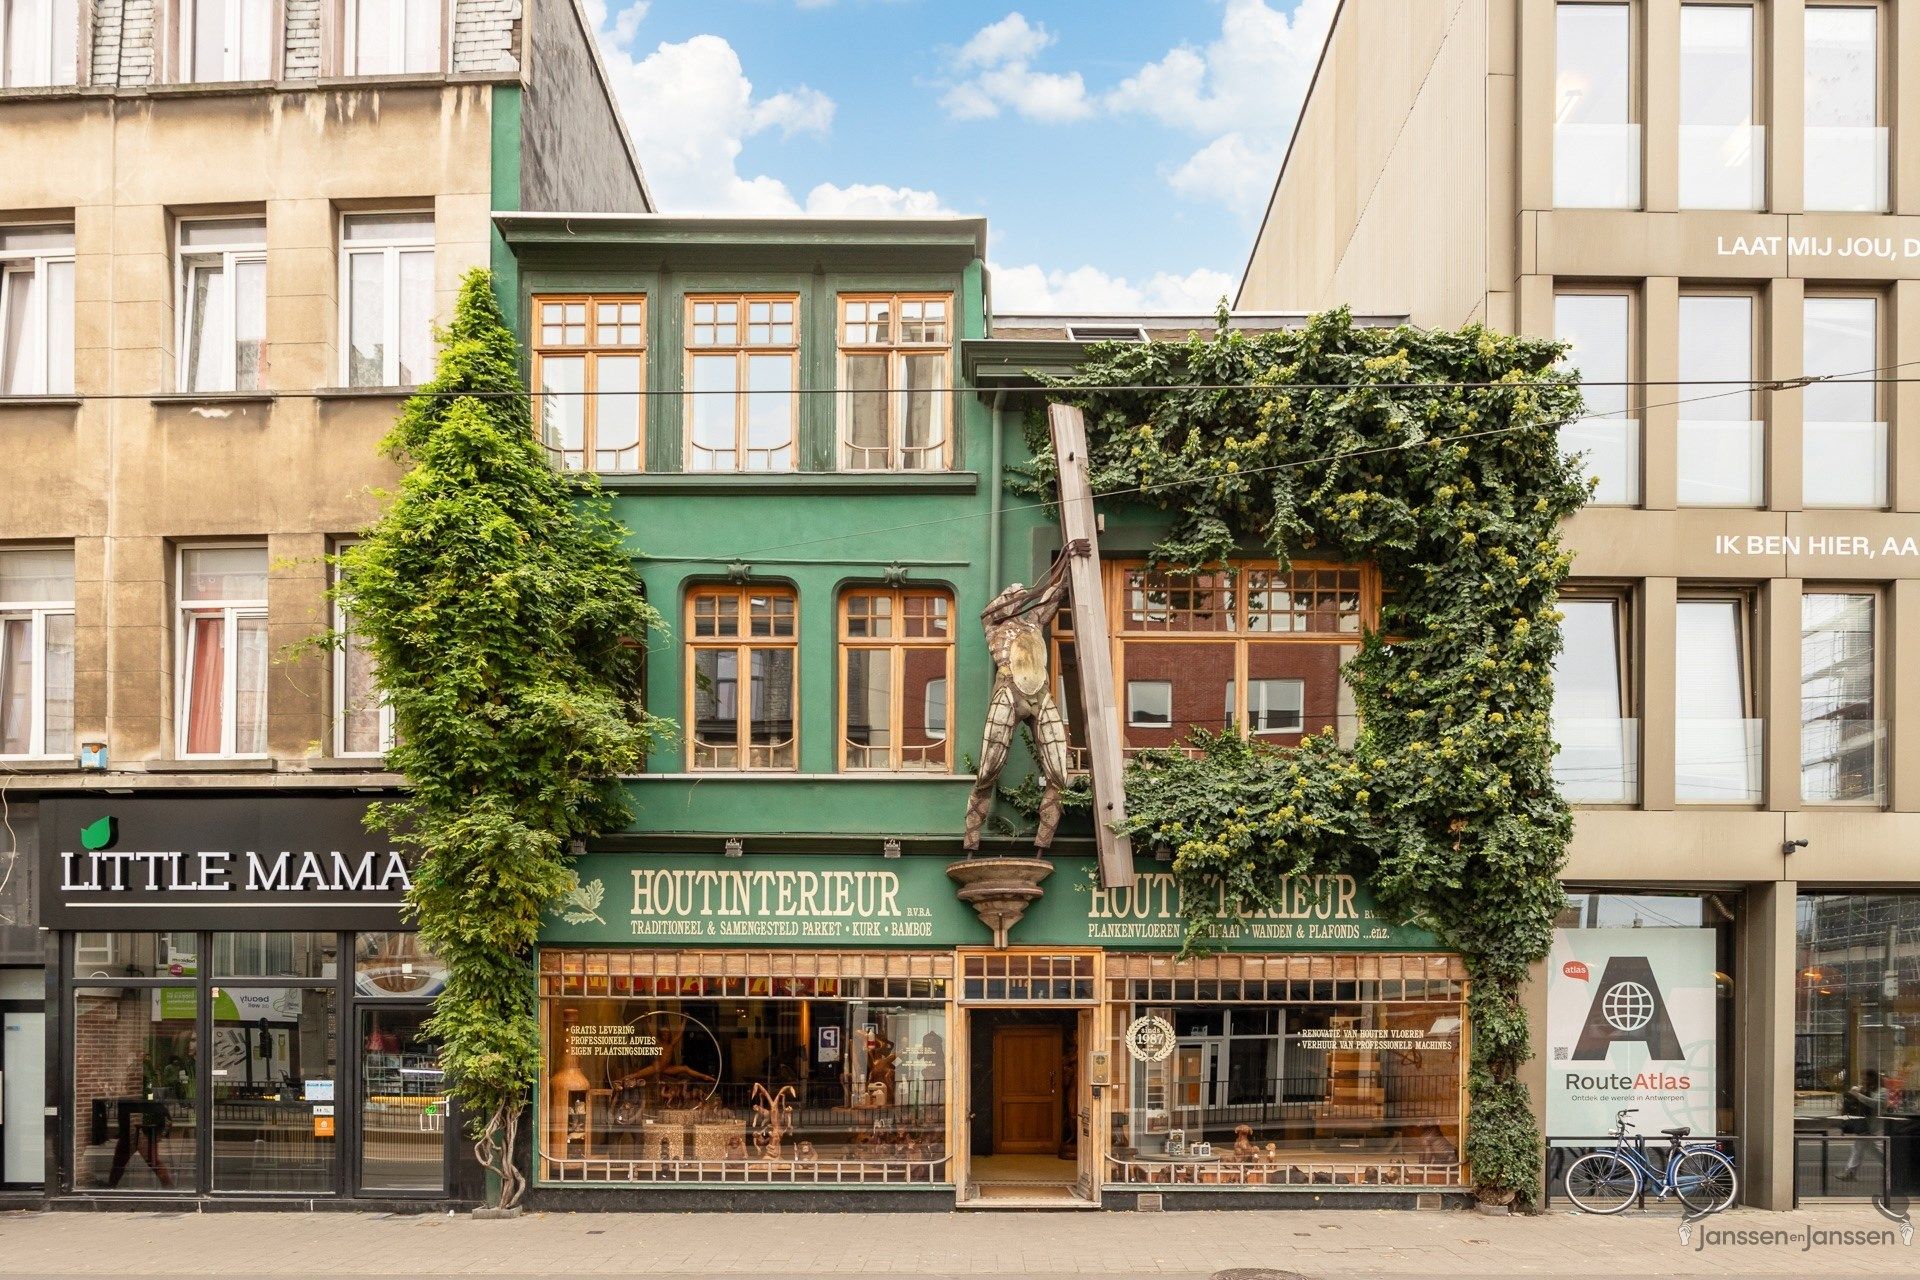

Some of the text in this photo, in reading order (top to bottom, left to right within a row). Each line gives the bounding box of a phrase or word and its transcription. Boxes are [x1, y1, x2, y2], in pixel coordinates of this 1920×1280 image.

[1717, 236, 1782, 256] LAAT
[1787, 236, 1832, 257] MIJ
[1838, 237, 1897, 261] JOU,
[1716, 535, 1920, 559] IK BEN HIER, AA
[60, 851, 415, 891] LITTLE MAMA
[630, 869, 902, 917] HOUTINTERIEUR
[631, 920, 933, 937] TRADITIONEEL & SAMENGESTELD PARKET KURK BAMBOE
[1088, 923, 1181, 938] PLANKENVLOEREN
[1252, 924, 1293, 939] WANDEN
[1296, 924, 1305, 939] &
[1309, 924, 1360, 939] PLAFONDS
[1564, 966, 1587, 974] atlas
[570, 1025, 635, 1035] GRATIS LEVERING
[1140, 1026, 1161, 1034] sinds
[1302, 1029, 1424, 1039] RENOVATIE VAN HOUTEN VLOEREN
[570, 1036, 656, 1045] PROFESSIONEEL ADVIES
[1136, 1033, 1164, 1045] 1987
[570, 1046, 664, 1056] EIGEN PLAATSINGSDIENST
[1302, 1040, 1452, 1051] VERHUUR VAN PROFESSIONELE MACHINES
[1566, 1073, 1691, 1090] RouteAtlas
[1571, 1094, 1685, 1103] Ontdek de wereld in Antwerpen
